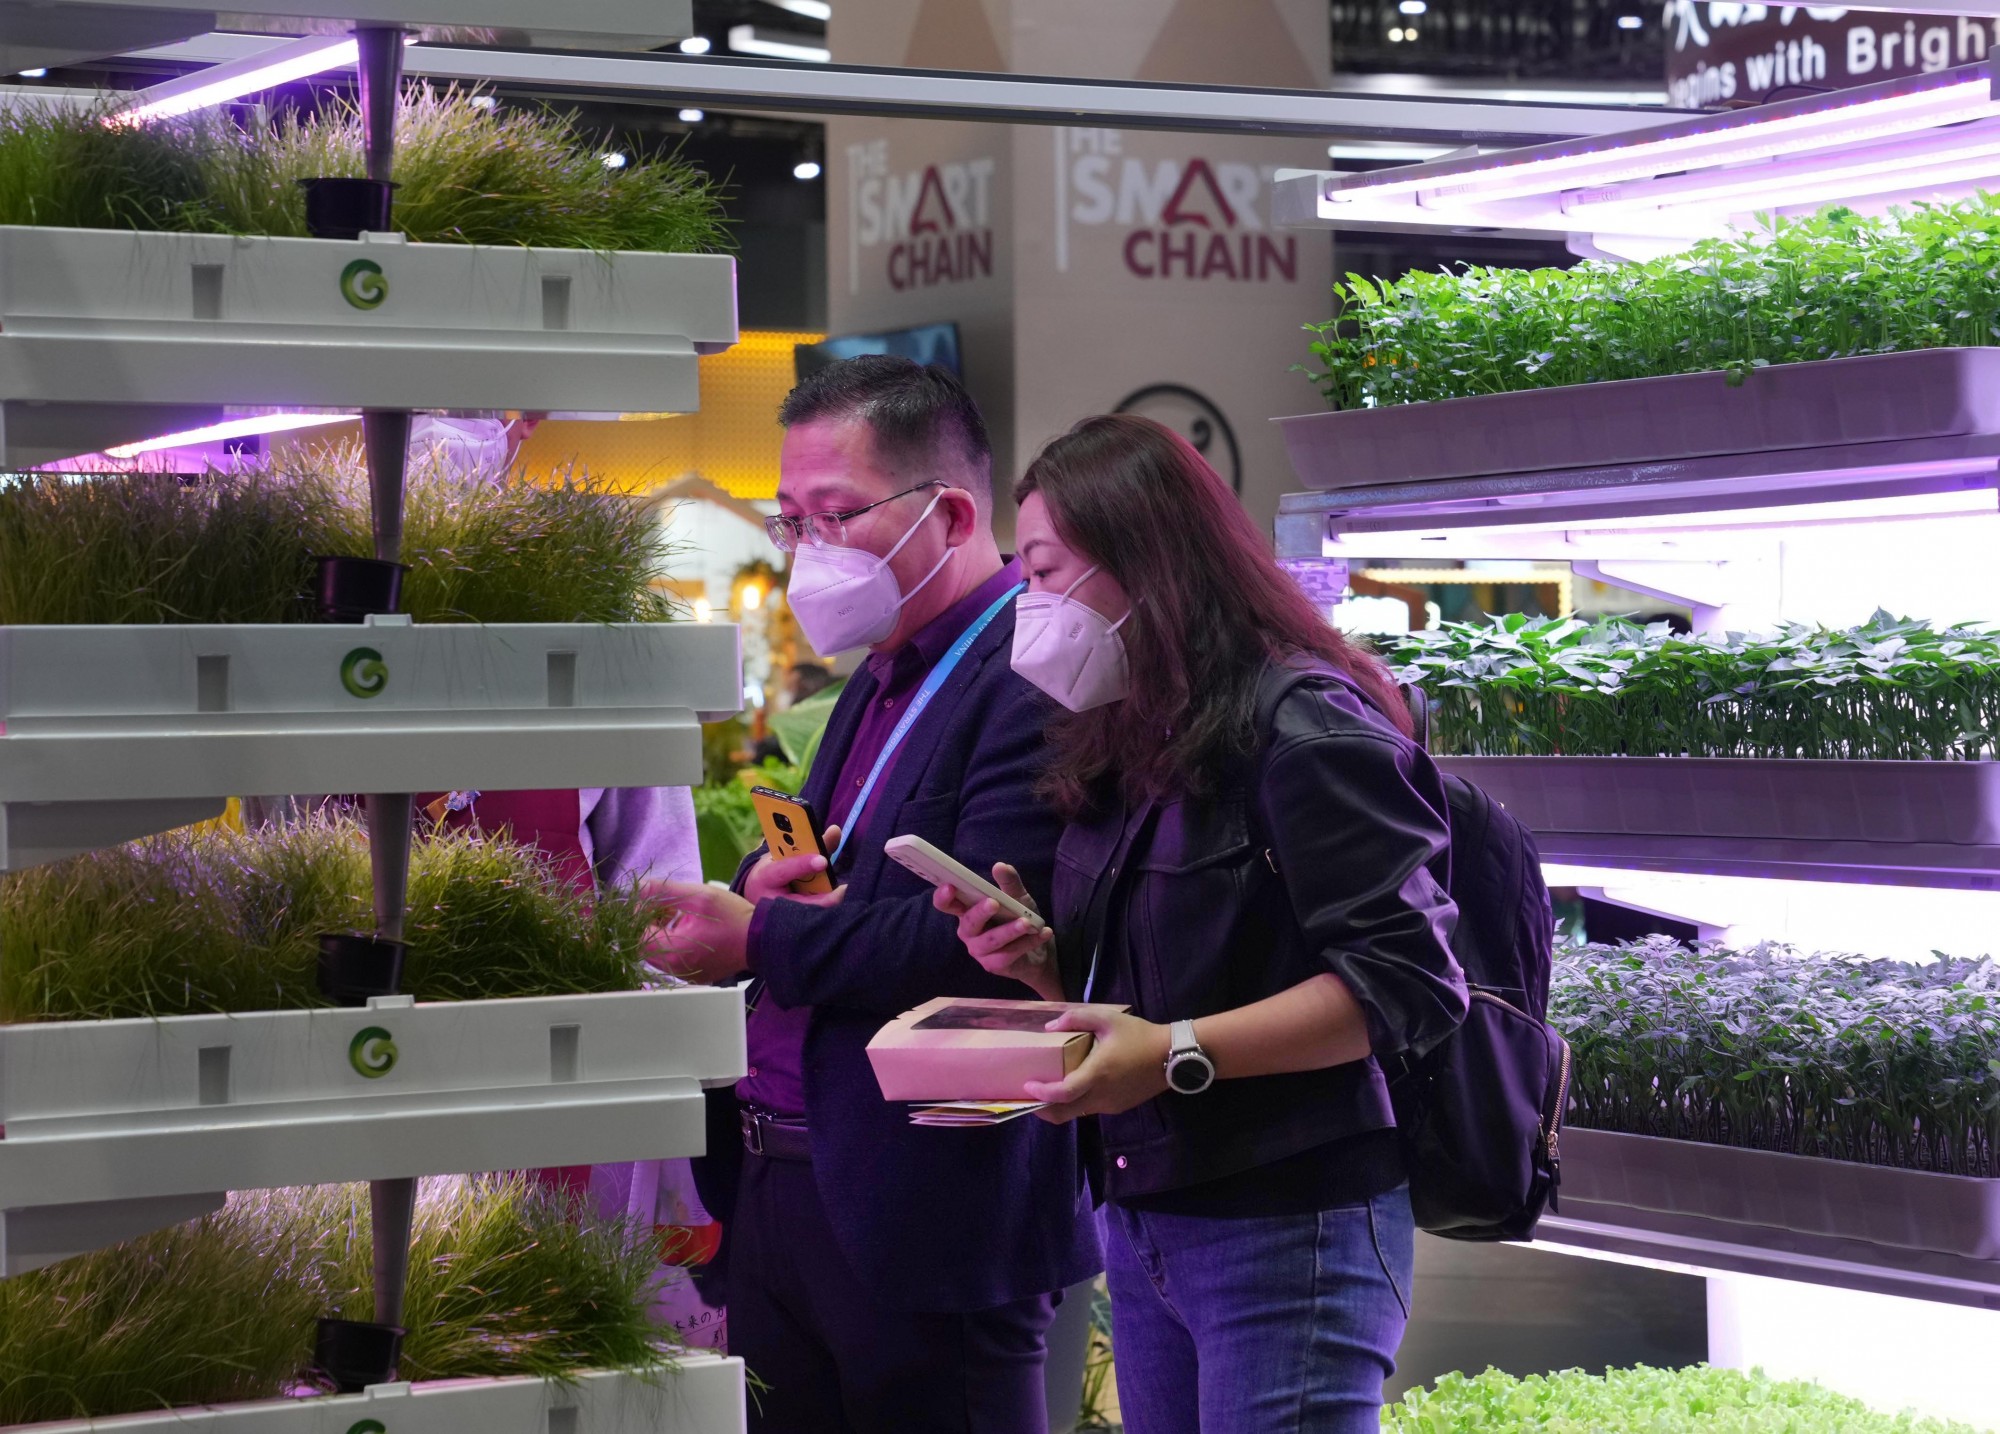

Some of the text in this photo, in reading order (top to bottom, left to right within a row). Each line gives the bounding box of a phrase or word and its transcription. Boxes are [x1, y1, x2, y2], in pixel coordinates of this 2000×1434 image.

[1746, 35, 1826, 91] with
[861, 158, 994, 246] SMART
[888, 228, 992, 292] CHAIN
[1123, 230, 1298, 283] CHAIN
[954, 632, 979, 657] CHINA
[916, 688, 931, 707] THE
[885, 708, 918, 753] STRATEGIC
